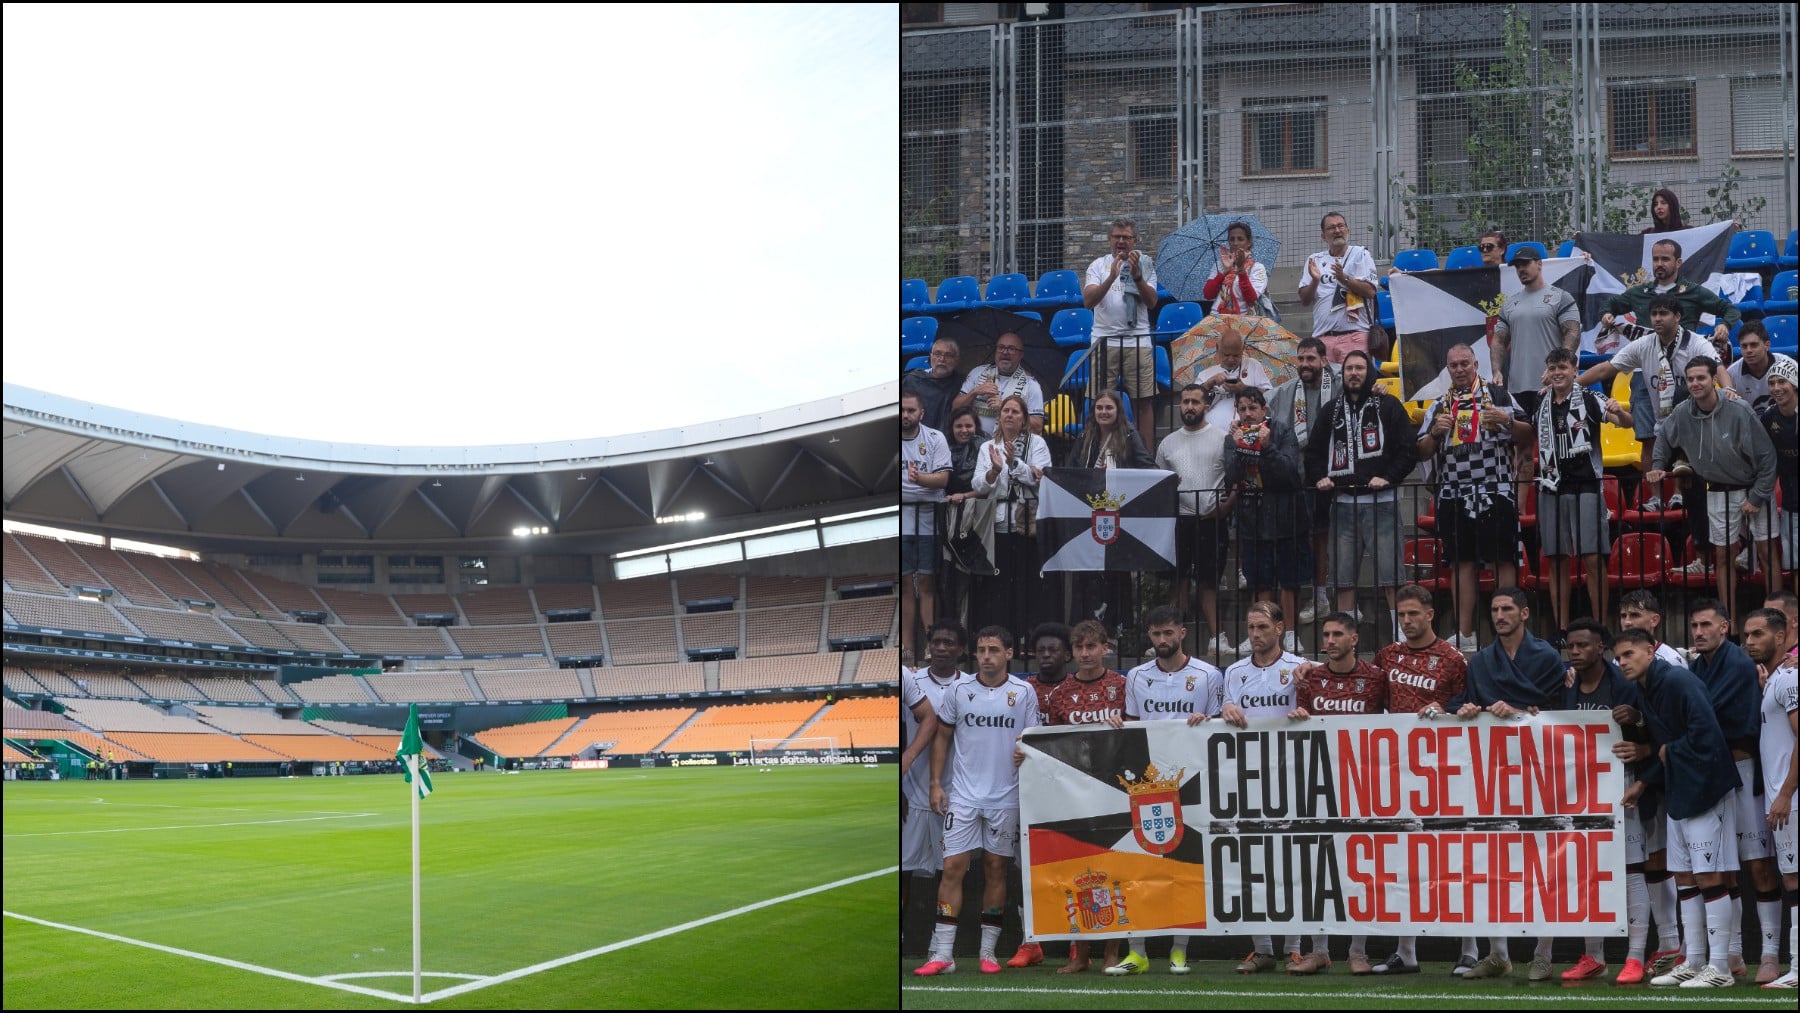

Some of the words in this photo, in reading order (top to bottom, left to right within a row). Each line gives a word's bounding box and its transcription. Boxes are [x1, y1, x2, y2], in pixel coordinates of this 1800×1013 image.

[1389, 668, 1437, 691] Ceuta
[1143, 698, 1195, 713] Ceuta
[1240, 692, 1290, 709] Ceuta
[1313, 696, 1366, 712] Ceuta
[964, 712, 1015, 728] Ceuta
[1068, 706, 1121, 725] Ceuta
[734, 757, 749, 765] Las
[780, 756, 818, 765] digitales
[821, 755, 860, 764] oficiales
[861, 754, 877, 763] del
[1208, 730, 1338, 819] CEUTA
[1338, 728, 1401, 817] NO
[1408, 728, 1464, 816] SE
[1467, 724, 1613, 816] VENDE
[1211, 834, 1346, 922] CEUTA
[1346, 834, 1401, 922] SE
[1408, 831, 1616, 923] DEFIENDE
